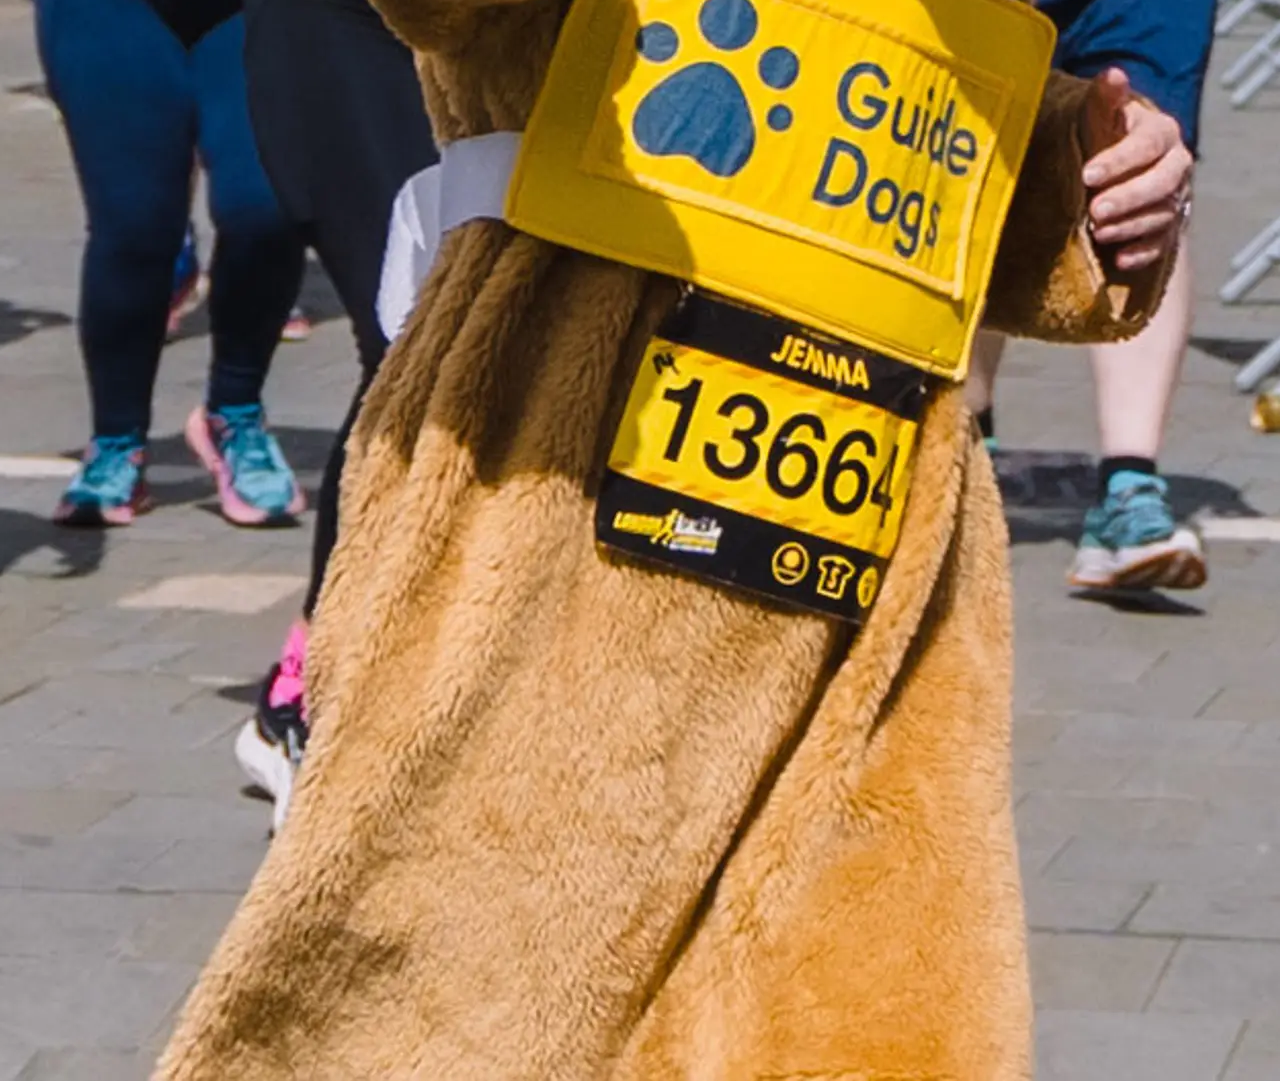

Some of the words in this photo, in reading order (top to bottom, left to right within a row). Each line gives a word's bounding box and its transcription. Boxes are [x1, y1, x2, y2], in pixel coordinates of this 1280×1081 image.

[837, 62, 977, 176] Guide
[812, 136, 941, 258] Dogs
[771, 335, 870, 390] JEMMA
[662, 377, 899, 529] 13664
